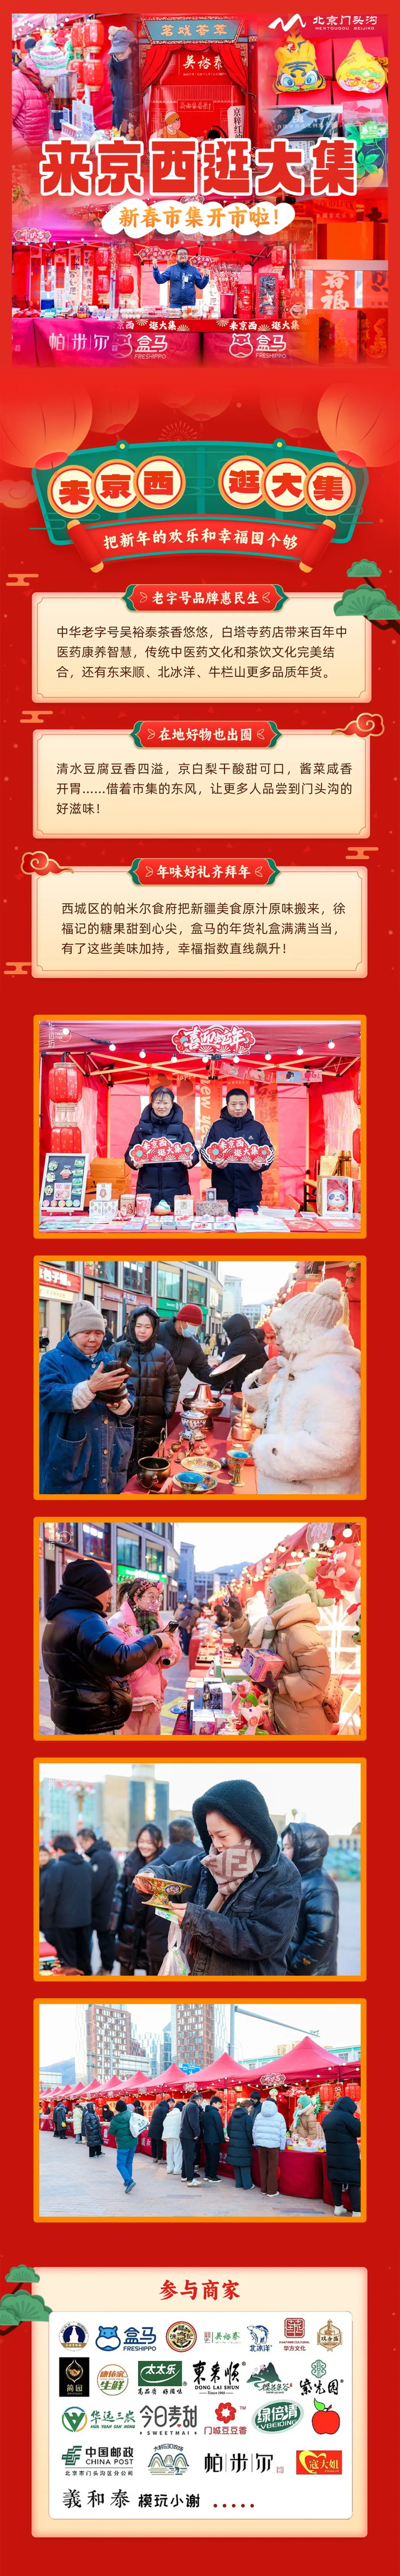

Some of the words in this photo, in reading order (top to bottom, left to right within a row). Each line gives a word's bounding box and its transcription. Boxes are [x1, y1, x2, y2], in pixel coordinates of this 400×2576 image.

[161, 24, 228, 36] 茗戏荟萃
[183, 54, 222, 70] 吴裕泰
[149, 320, 176, 330] 逛大集
[229, 321, 258, 331] 来京西
[271, 320, 300, 330] 逛大集
[49, 333, 109, 351] 帕米尔
[135, 335, 168, 352] 盒马
[256, 335, 287, 351] 盒马
[184, 1026, 246, 1051] 喜迎蛇年
[142, 1138, 168, 1149] 来京西
[219, 1138, 244, 1149] 来京西
[158, 1146, 182, 1156] 逛大集
[234, 1146, 258, 1156] 逛大集
